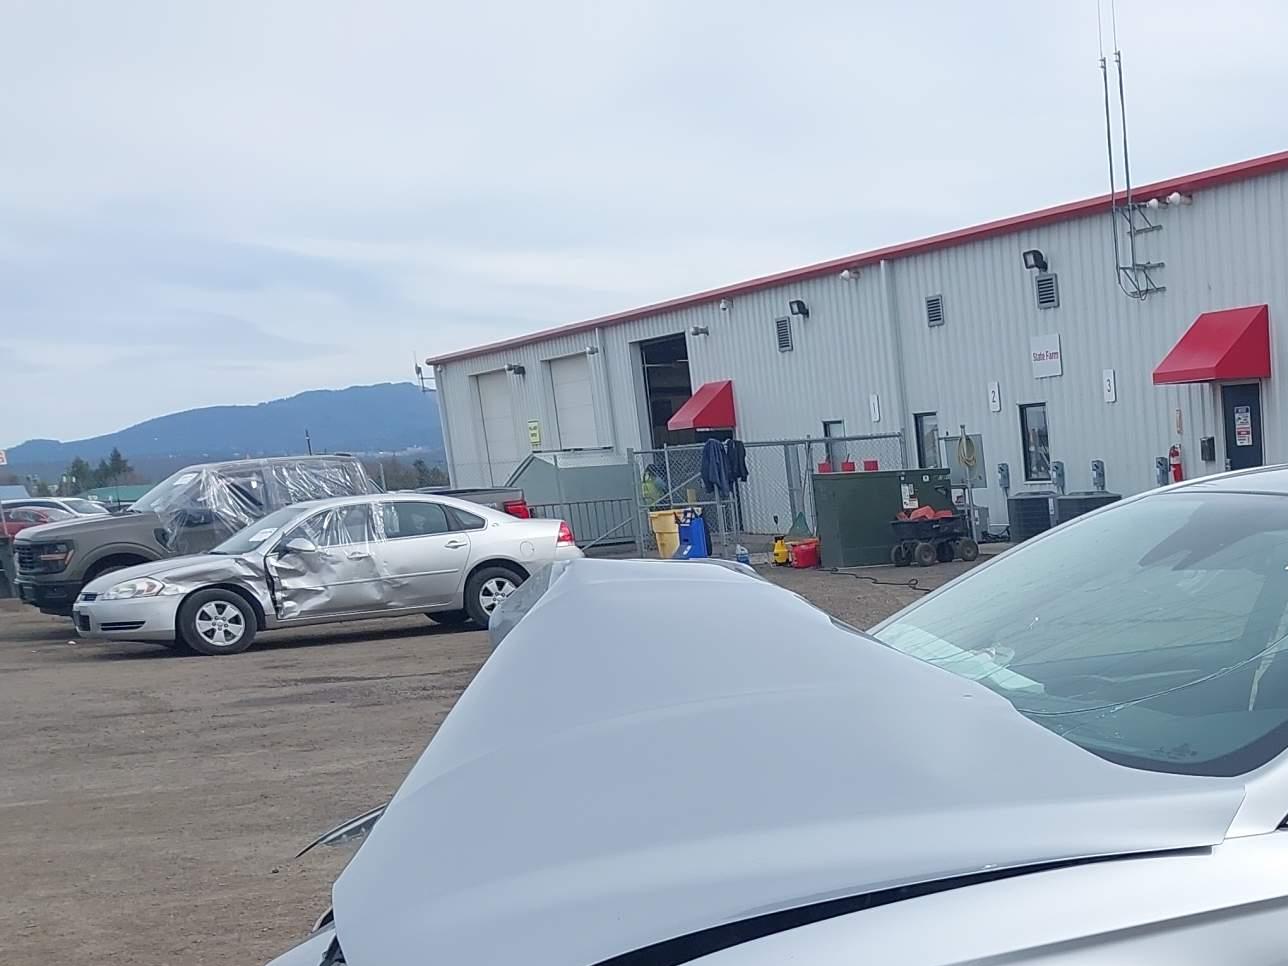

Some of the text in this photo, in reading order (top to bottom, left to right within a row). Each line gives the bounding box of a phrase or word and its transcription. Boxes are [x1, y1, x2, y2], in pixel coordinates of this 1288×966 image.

[1032, 350, 1059, 362] State Farm
[1106, 379, 1112, 393] 3
